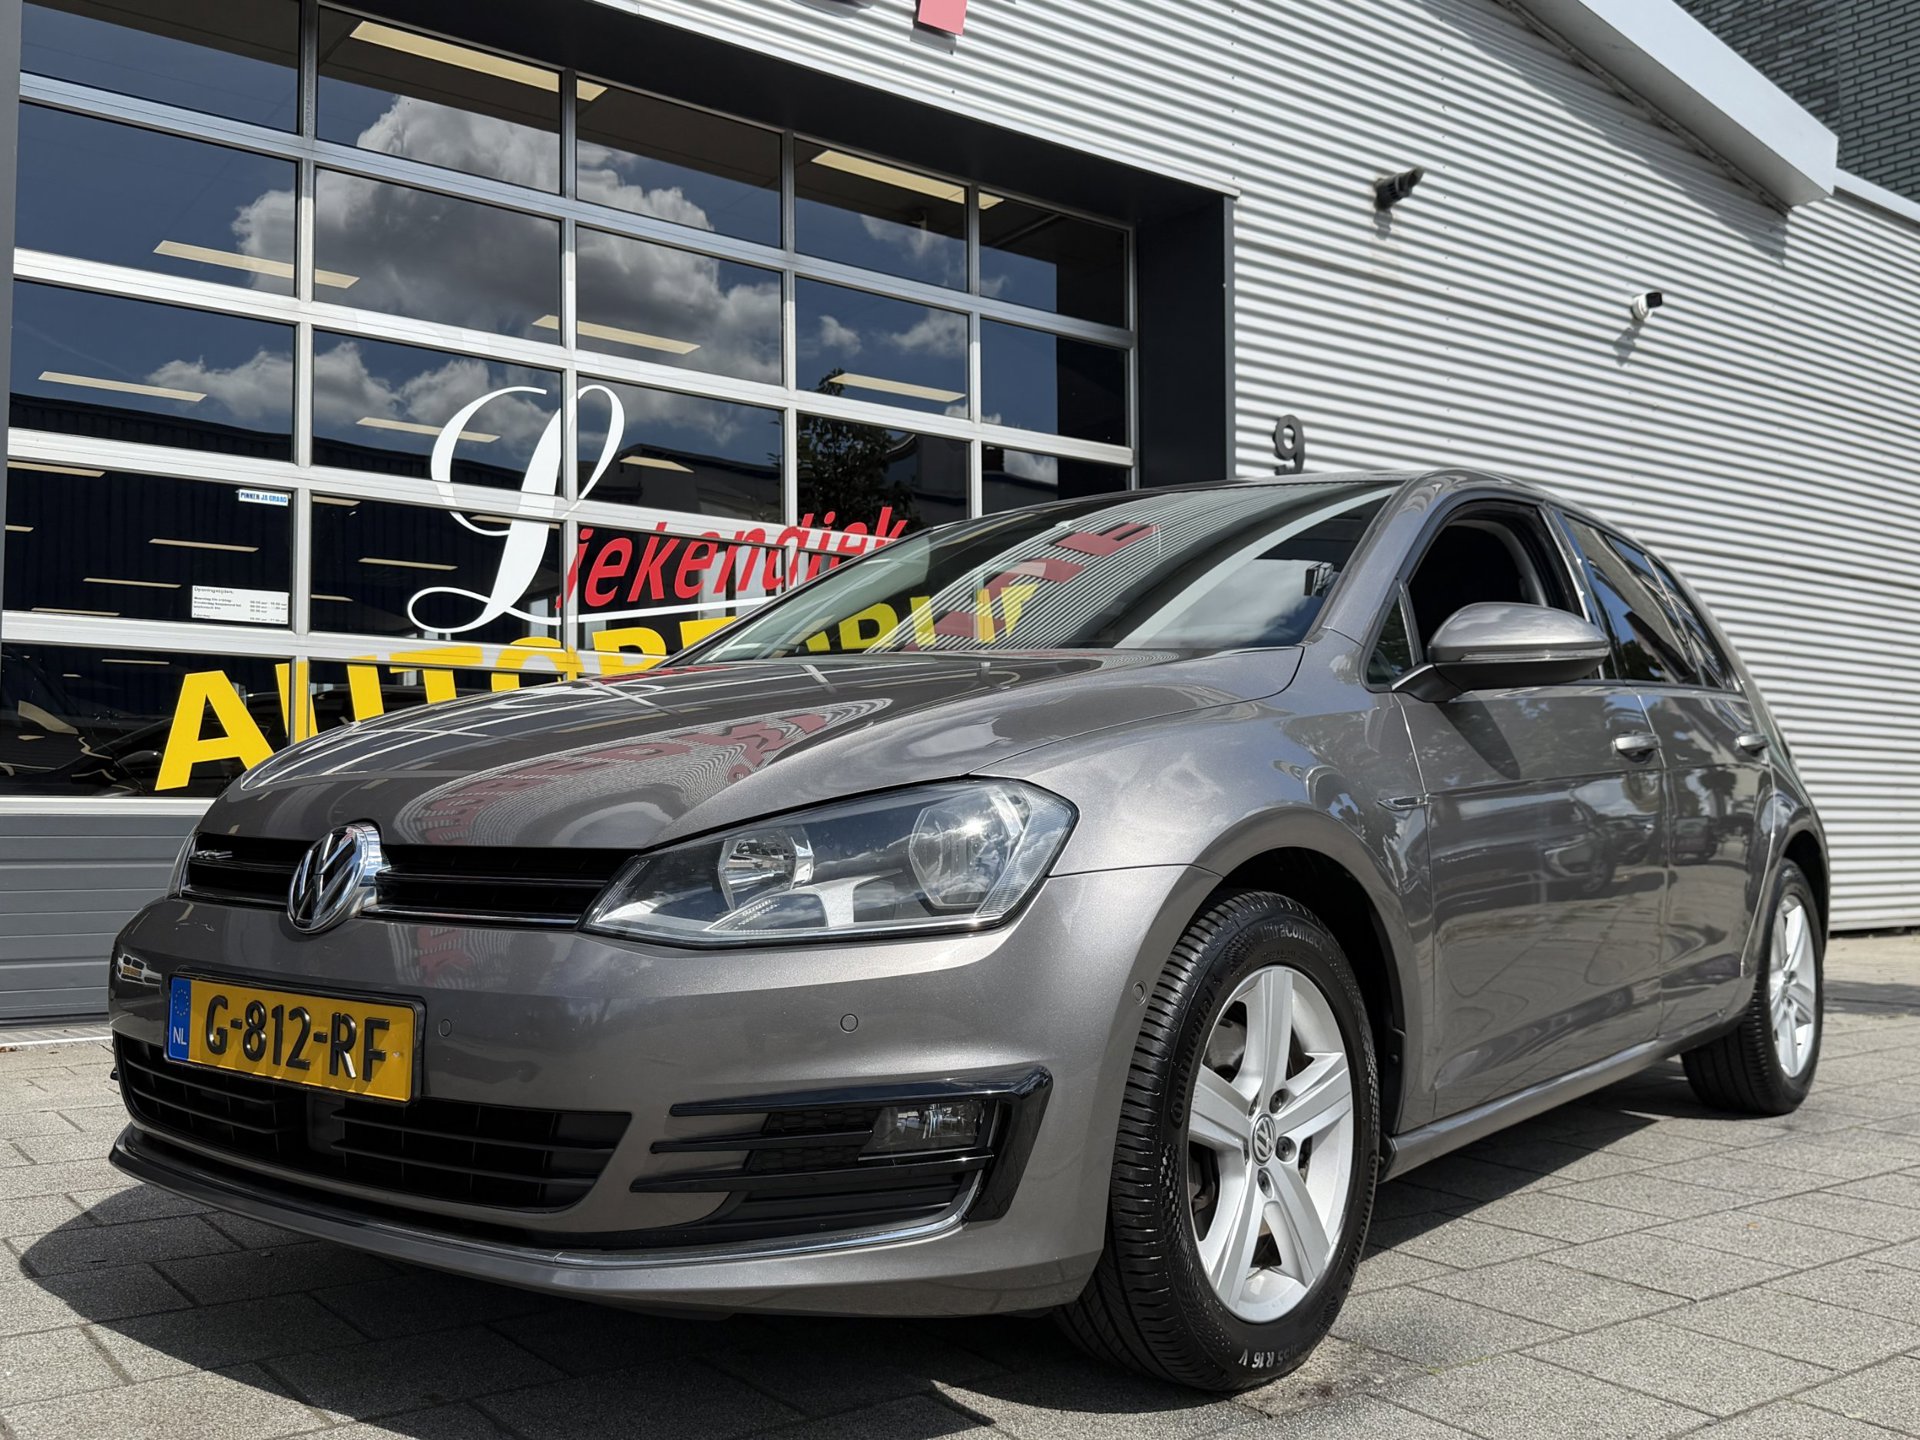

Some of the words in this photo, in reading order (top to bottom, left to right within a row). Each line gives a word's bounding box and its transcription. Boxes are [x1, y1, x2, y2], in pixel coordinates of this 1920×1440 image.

[1272, 414, 1305, 476] 9
[172, 1025, 188, 1046] NL
[205, 994, 391, 1083] G-812-RF
